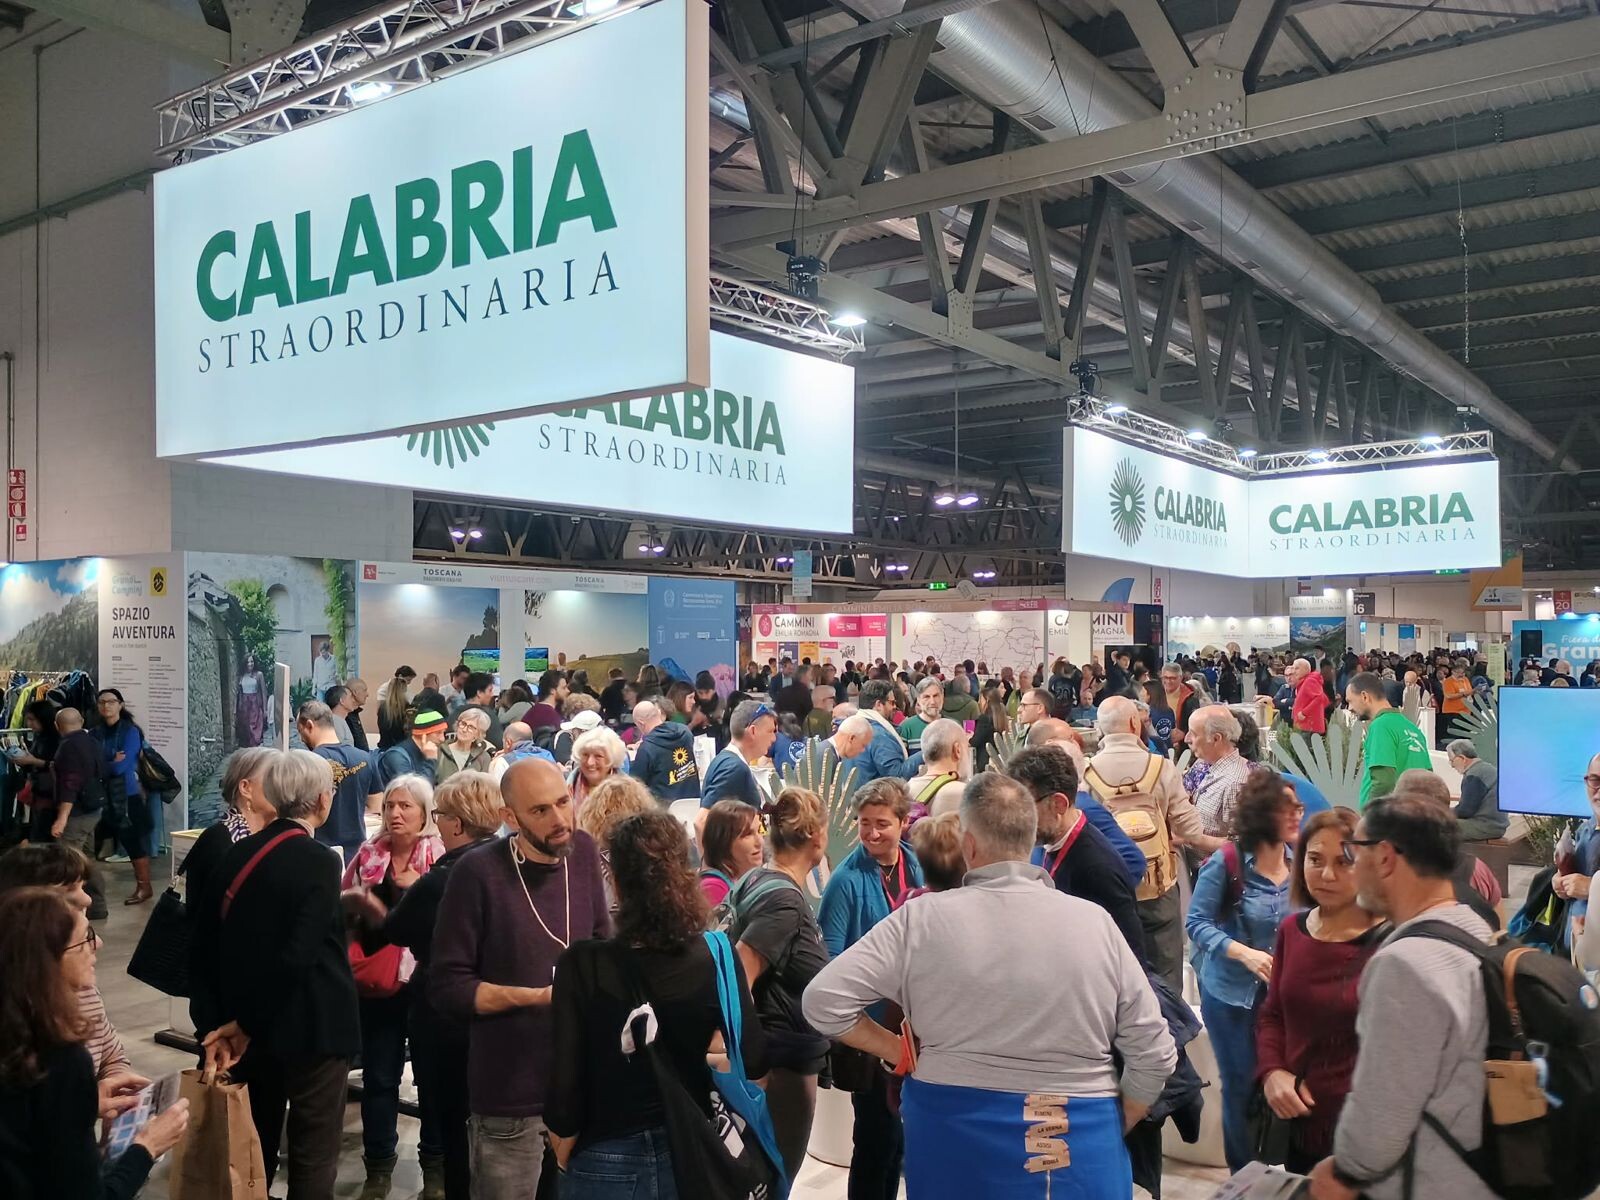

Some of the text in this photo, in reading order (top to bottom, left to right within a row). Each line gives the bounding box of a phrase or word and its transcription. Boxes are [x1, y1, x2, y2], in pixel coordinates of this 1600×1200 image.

[196, 128, 618, 322] CALABRIA
[198, 251, 620, 373] STRAORDINARIA
[538, 423, 787, 486] STRAORDINARIA
[1154, 485, 1228, 533] CALABRIA
[1269, 492, 1474, 535] CALABRIA
[1153, 522, 1228, 548] STRAORDINARIA
[1269, 527, 1476, 551] STRAORDINARIA
[423, 568, 463, 577] TOSCANA
[575, 576, 605, 584] TOSCANA
[112, 607, 150, 621] SPAZIO
[1555, 601, 1571, 610] 20
[112, 625, 176, 639] AVVENTURA
[774, 616, 815, 628] CAMMINI
